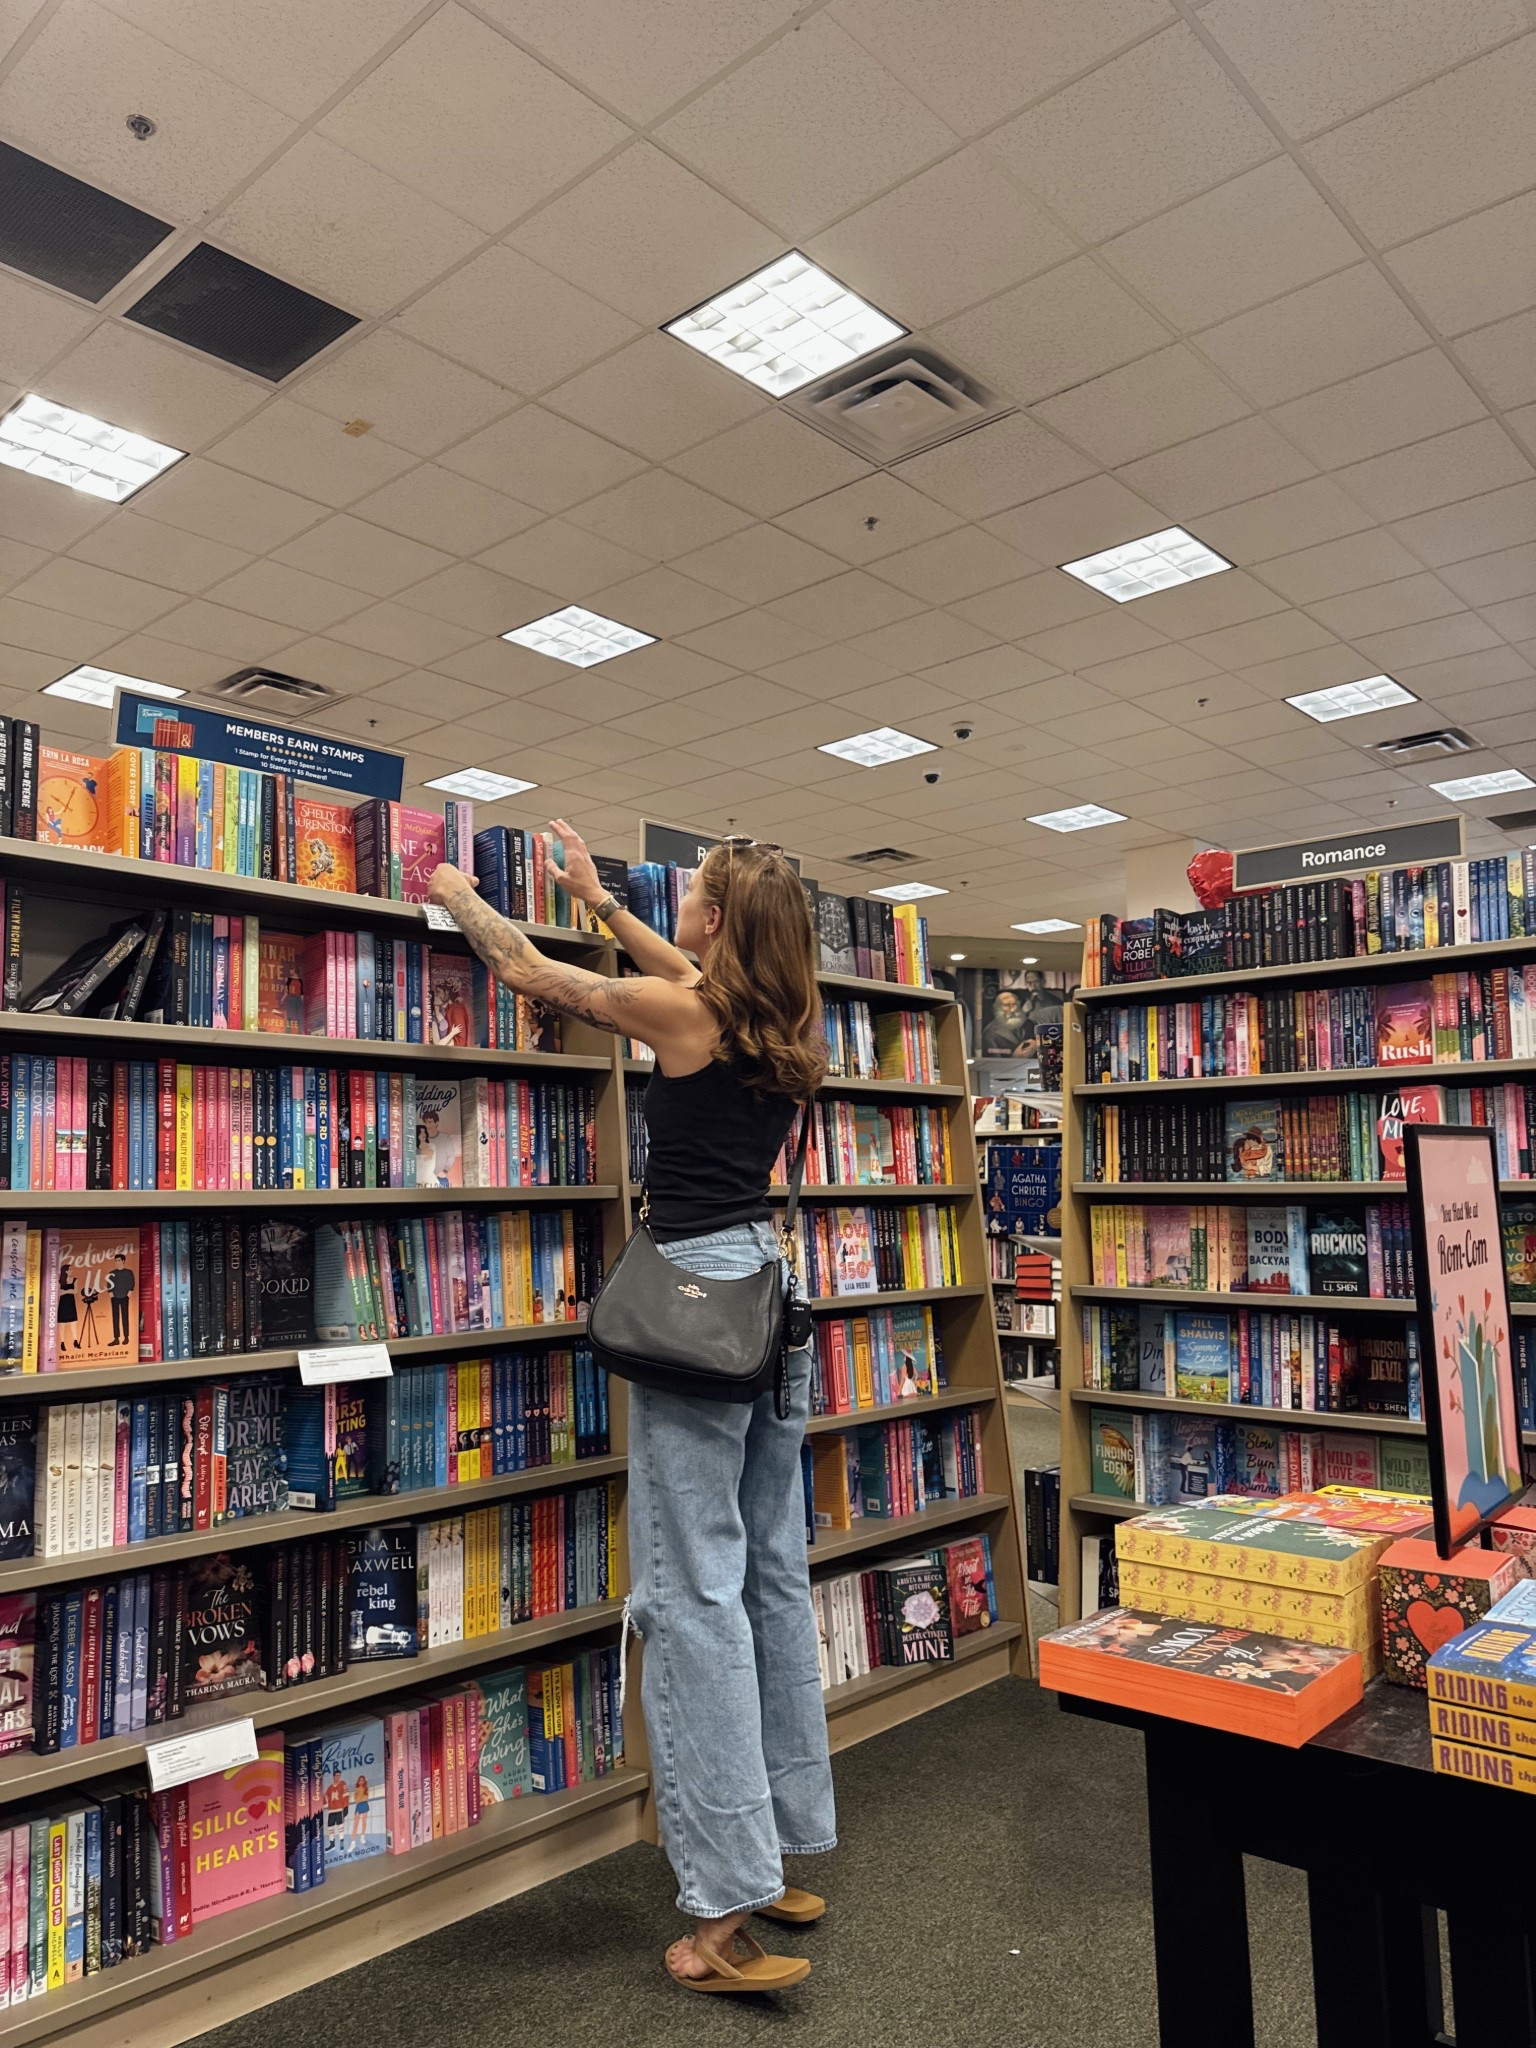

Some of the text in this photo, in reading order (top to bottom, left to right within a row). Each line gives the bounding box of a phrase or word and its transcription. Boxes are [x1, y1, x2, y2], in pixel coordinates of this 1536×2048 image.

[226, 724, 364, 763] MEMBERS EARN STAMPS
[42, 749, 90, 767] ERIN LA ROSA
[239, 748, 259, 759] Stamp
[271, 755, 286, 764] Every
[288, 758, 298, 766] $10
[299, 761, 315, 770] Spent
[328, 768, 352, 778] Purchase
[21, 738, 33, 808] HER SOUL REVENGE
[128, 752, 137, 806] COVER STORY
[269, 763, 291, 773] Stamps
[305, 770, 328, 780] Reward!
[264, 779, 272, 813] CHRISTINA
[300, 806, 337, 820] SHELLY
[294, 818, 352, 835] AURENSTON
[403, 823, 439, 837] McQuiston
[400, 840, 419, 858] NE
[1302, 843, 1387, 868] Romance
[514, 836, 524, 886] SOUL WITCH
[400, 863, 438, 884] LAS
[400, 891, 430, 905] TOP
[1185, 918, 1211, 934] lovely
[1125, 938, 1155, 949] KATE
[1122, 948, 1155, 961] ROBER
[272, 982, 296, 993] REPAIR
[264, 1019, 299, 1029] PIPER LEE
[1381, 1039, 1432, 1061] Rush
[33, 1058, 42, 1117] REAL LOVE
[45, 1061, 56, 1117] REAL LOVE
[163, 1065, 172, 1117] TRUTH BEARD
[319, 1073, 327, 1093] FOR
[0, 1081, 9, 1109] DIRTY
[15, 1067, 27, 1140] the right notes
[306, 1090, 315, 1117] Rival
[415, 1084, 457, 1108] edding
[1381, 1095, 1426, 1120] LOVE,
[520, 1125, 529, 1153] CRASH
[1012, 1174, 1047, 1184] AGATHA
[1012, 1185, 1047, 1196] CHRISTIE
[1014, 1198, 1044, 1208] BINGO
[1441, 1201, 1478, 1223] You Had Me at
[836, 1223, 869, 1238] LOVE
[231, 1224, 240, 1270] SCARRED
[849, 1244, 859, 1256] AT
[1261, 1245, 1268, 1253] IN
[1311, 1233, 1366, 1256] RUCKUS
[1438, 1229, 1488, 1275] Rom-Com
[60, 1243, 135, 1268] Between
[1250, 1255, 1289, 1266] BACKYAR
[1507, 1252, 1534, 1263] YOU
[84, 1269, 116, 1297] Us
[1323, 1282, 1358, 1292] L.J. SHEN
[1179, 1329, 1225, 1340] SHALVIS
[1192, 1320, 1212, 1329] JILL
[59, 1349, 129, 1361] Mhairi McFarlane
[1188, 1343, 1221, 1356] Summer
[1194, 1354, 1224, 1364] Escape
[1361, 1341, 1407, 1359] HANDSOM
[1370, 1359, 1403, 1382] DEVIL
[230, 1385, 280, 1418] EANT
[1384, 1403, 1408, 1412] SHEN
[217, 1393, 227, 1451] Slipstream
[257, 1416, 282, 1443] ME
[1245, 1433, 1275, 1450] Slow
[1095, 1444, 1134, 1461] FINDING
[1246, 1454, 1276, 1470] Burn
[1327, 1450, 1353, 1466] WILD
[233, 1459, 262, 1483] TAY
[1103, 1460, 1128, 1475] EDEN
[1328, 1464, 1354, 1480] LOVE
[1384, 1459, 1411, 1474] WILD
[1386, 1473, 1411, 1489] SIDE
[228, 1480, 280, 1509] ARLEY
[49, 1512, 57, 1541] MANN
[395, 1537, 406, 1550] L.
[346, 1557, 415, 1574] AXWELL
[909, 1583, 931, 1591] RITCHIE
[924, 1573, 944, 1582] BECCA
[208, 1585, 229, 1607] The
[357, 1583, 388, 1597] rebel
[369, 1596, 396, 1611] king
[188, 1620, 245, 1646] VOWS
[1147, 1627, 1216, 1657] VOWS
[66, 1615, 77, 1688] DEBBIE MASON
[903, 1640, 950, 1663] MINE
[1170, 1629, 1252, 1665] BROKEN
[185, 1676, 256, 1697] THARINA MAURA
[1434, 1671, 1533, 1711] RIDING the
[486, 1684, 524, 1718] What
[491, 1713, 523, 1748] She's
[1437, 1707, 1511, 1747] RIDING
[321, 1735, 366, 1766] Rival
[323, 1753, 375, 1775] ARLING
[503, 1768, 526, 1779] LAURA
[1439, 1744, 1514, 1785] RIDING
[254, 1824, 269, 1834] Novel
[195, 1831, 279, 1874] HEARTS
[354, 1845, 381, 1859] MOODY
[53, 1908, 61, 1926] FUN
